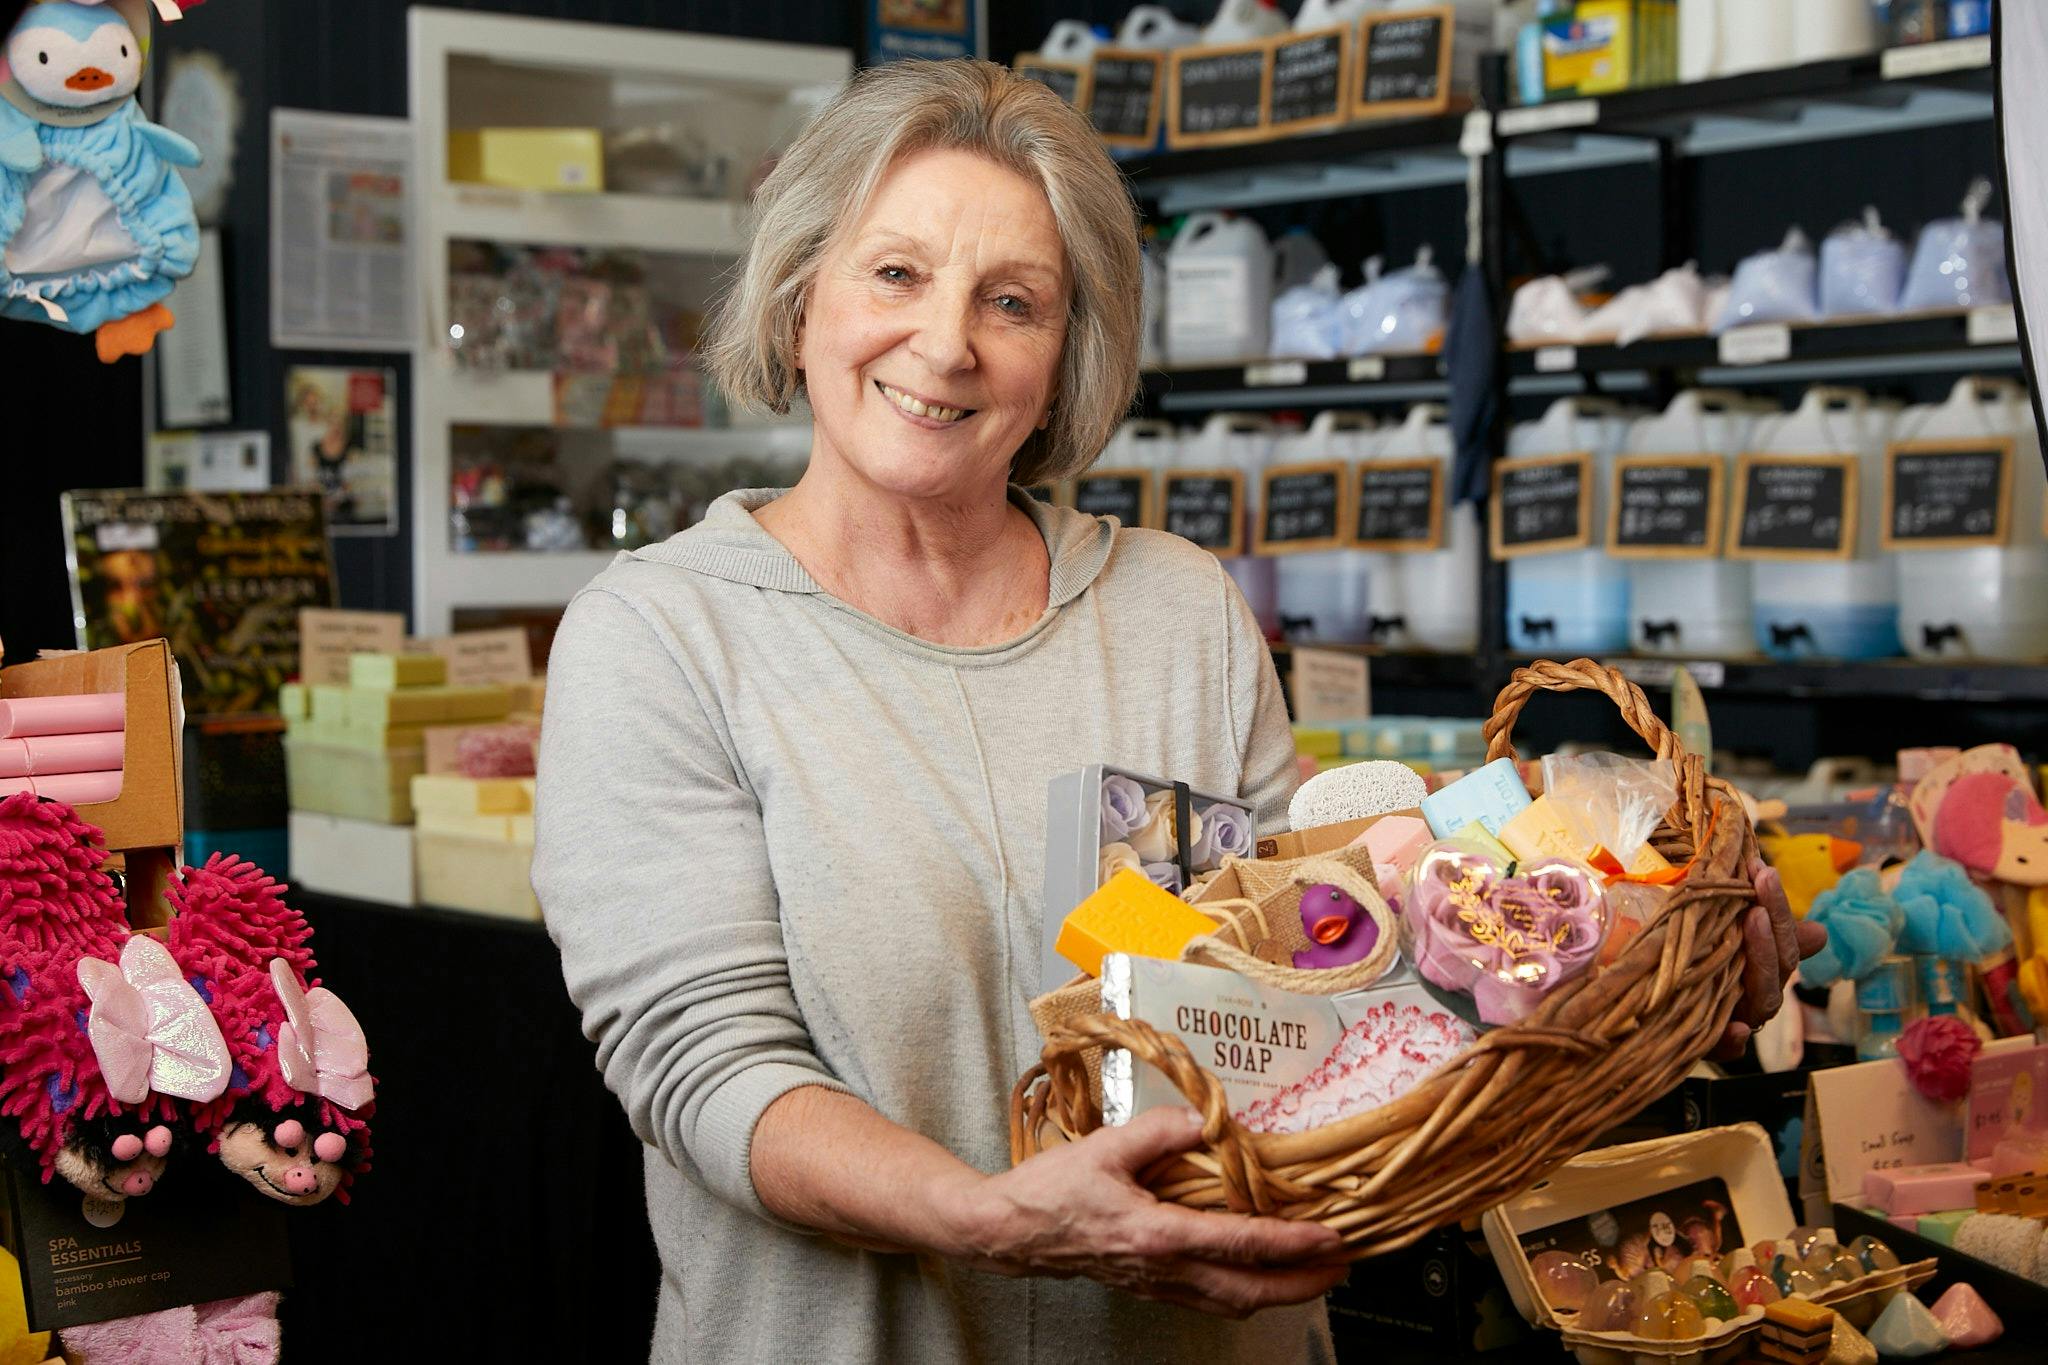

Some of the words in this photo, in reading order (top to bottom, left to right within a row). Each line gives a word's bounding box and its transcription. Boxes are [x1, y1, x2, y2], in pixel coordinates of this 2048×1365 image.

[1177, 1005, 1307, 1050] CHOCOLATE
[1214, 1041, 1272, 1074] SOAP
[48, 1236, 79, 1252] SPA
[51, 1240, 142, 1266] ESSENTIALS
[54, 1272, 94, 1284] accessory
[55, 1282, 104, 1297] bamboo
[106, 1275, 148, 1289] shower
[151, 1270, 172, 1283] cap
[56, 1298, 78, 1310] pink
